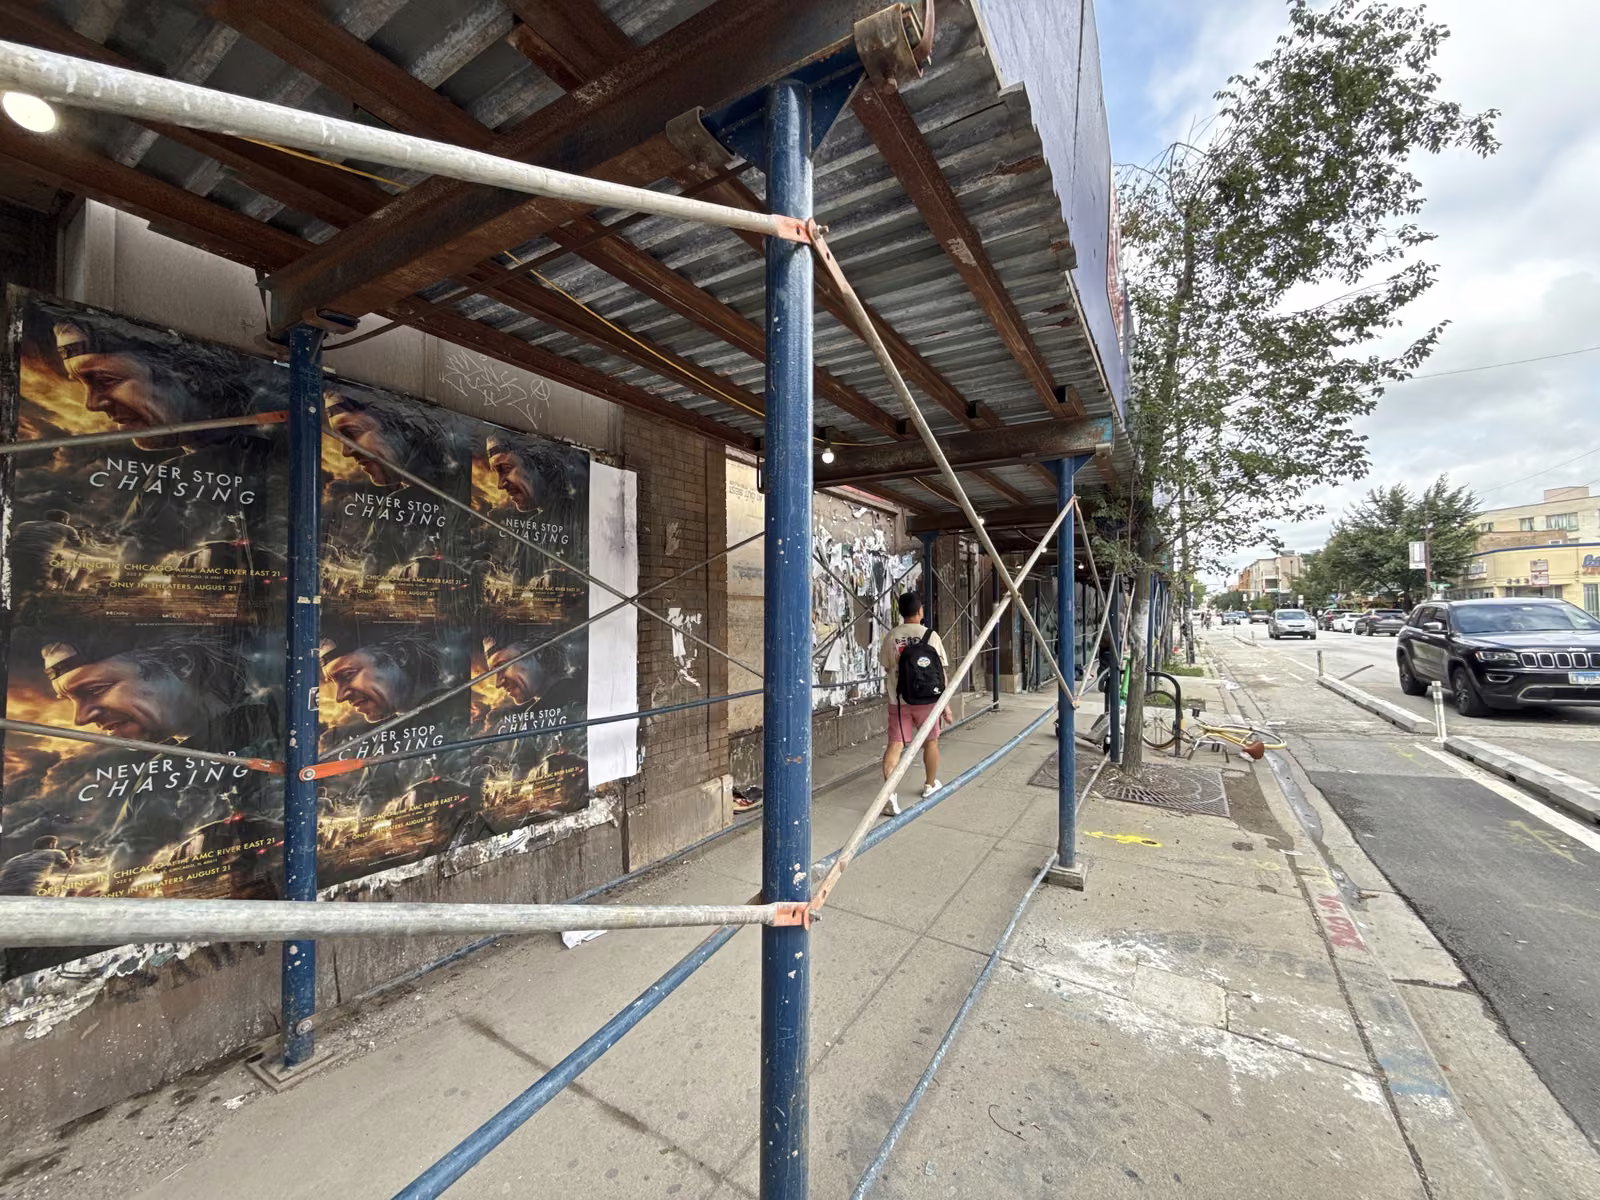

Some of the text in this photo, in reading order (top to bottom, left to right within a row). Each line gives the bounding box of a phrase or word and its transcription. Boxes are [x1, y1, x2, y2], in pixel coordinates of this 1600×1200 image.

[107, 457, 243, 488] NEVER STOP
[89, 472, 256, 504] CHASING
[354, 493, 440, 514] NEVER STOP
[344, 504, 446, 528] CHASING
[506, 518, 564, 533] NEVER STOP
[499, 529, 568, 544] CASING
[49, 559, 104, 570] OPENING
[108, 561, 120, 570] IN
[124, 564, 173, 573] CHICAGO
[200, 566, 221, 575] AMC
[224, 568, 248, 576] RIVER
[250, 569, 270, 577] EAST
[365, 574, 396, 582] CHICAGO
[109, 581, 135, 589] ONLY
[151, 583, 191, 591] THEATERS
[194, 584, 227, 592] AUGUST
[498, 716, 568, 734] CHASING
[504, 708, 561, 724] NEVER STOP
[403, 726, 436, 738] STOP
[338, 735, 443, 760] CHASING
[96, 758, 173, 781] NEVER
[78, 766, 248, 802] CHASING
[361, 811, 392, 823] CHICAGO
[424, 800, 439, 808] RIVER
[440, 796, 453, 805] EAST
[352, 832, 368, 840] ONLY
[405, 818, 426, 826] AUGUST
[36, 878, 94, 896] OPENING
[97, 872, 110, 884] IN
[114, 862, 164, 879] CHICAGO
[192, 851, 214, 862] AMC
[216, 844, 242, 857] RIVER
[244, 840, 264, 850] EAST
[266, 837, 276, 845] 21
[128, 886, 138, 894] IN
[141, 876, 184, 892] THEATERS
[186, 868, 220, 881] AUGUST
[222, 864, 232, 873] 21
